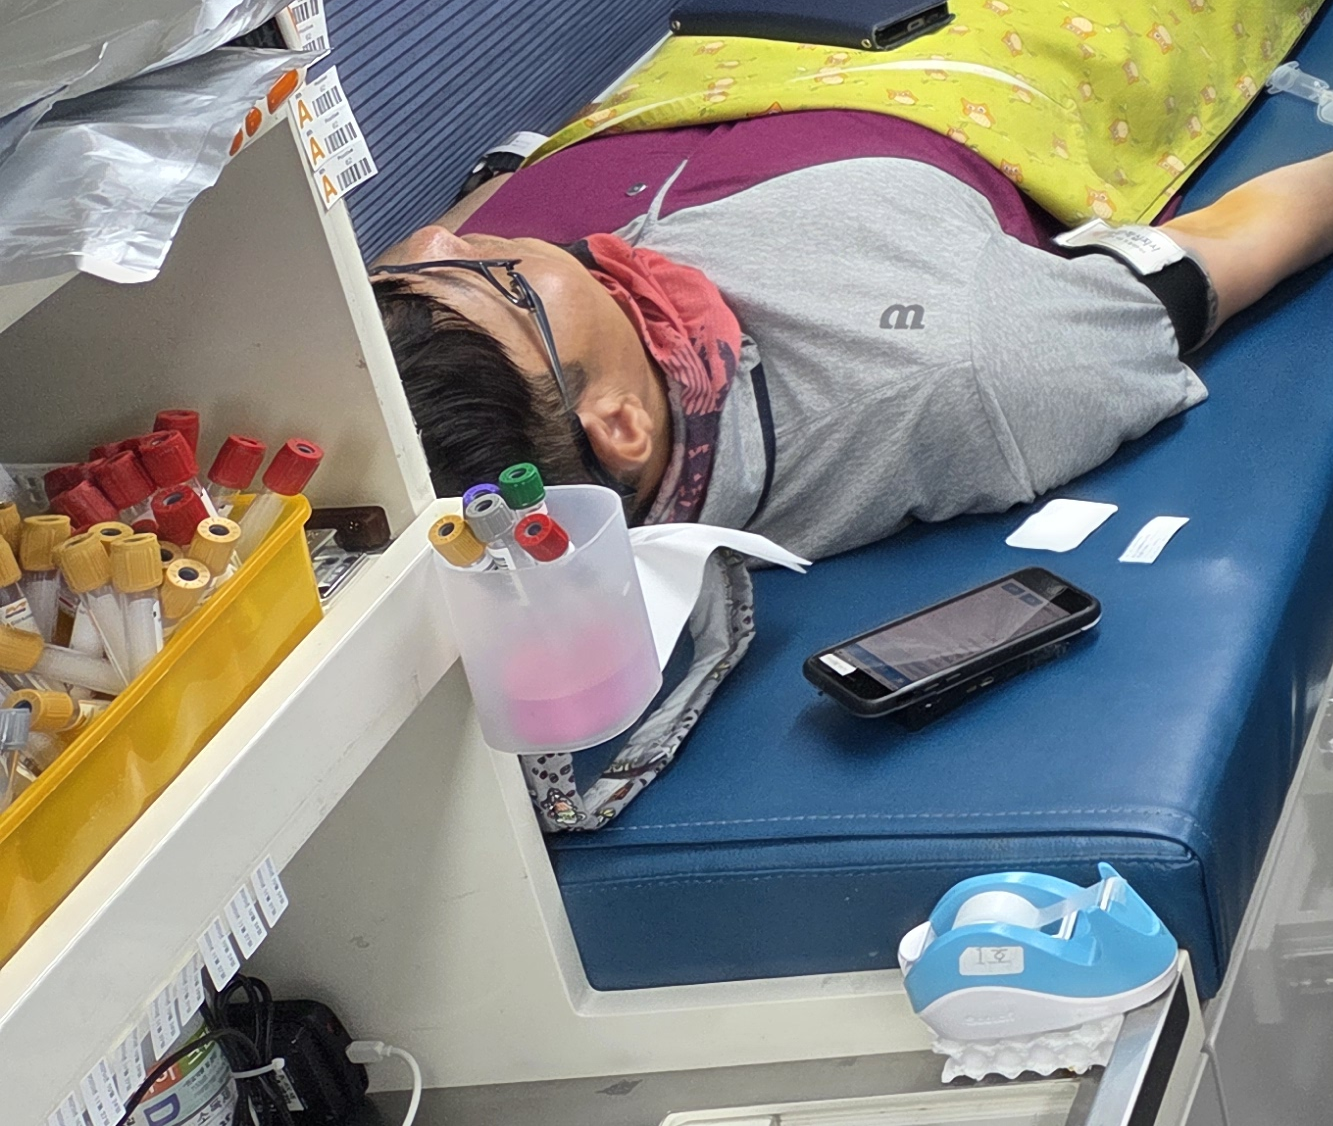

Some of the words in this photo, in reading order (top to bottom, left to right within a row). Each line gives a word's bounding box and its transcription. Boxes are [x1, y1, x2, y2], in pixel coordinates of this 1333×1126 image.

[297, 99, 313, 129] A
[310, 136, 325, 166] A
[322, 174, 338, 204] A
